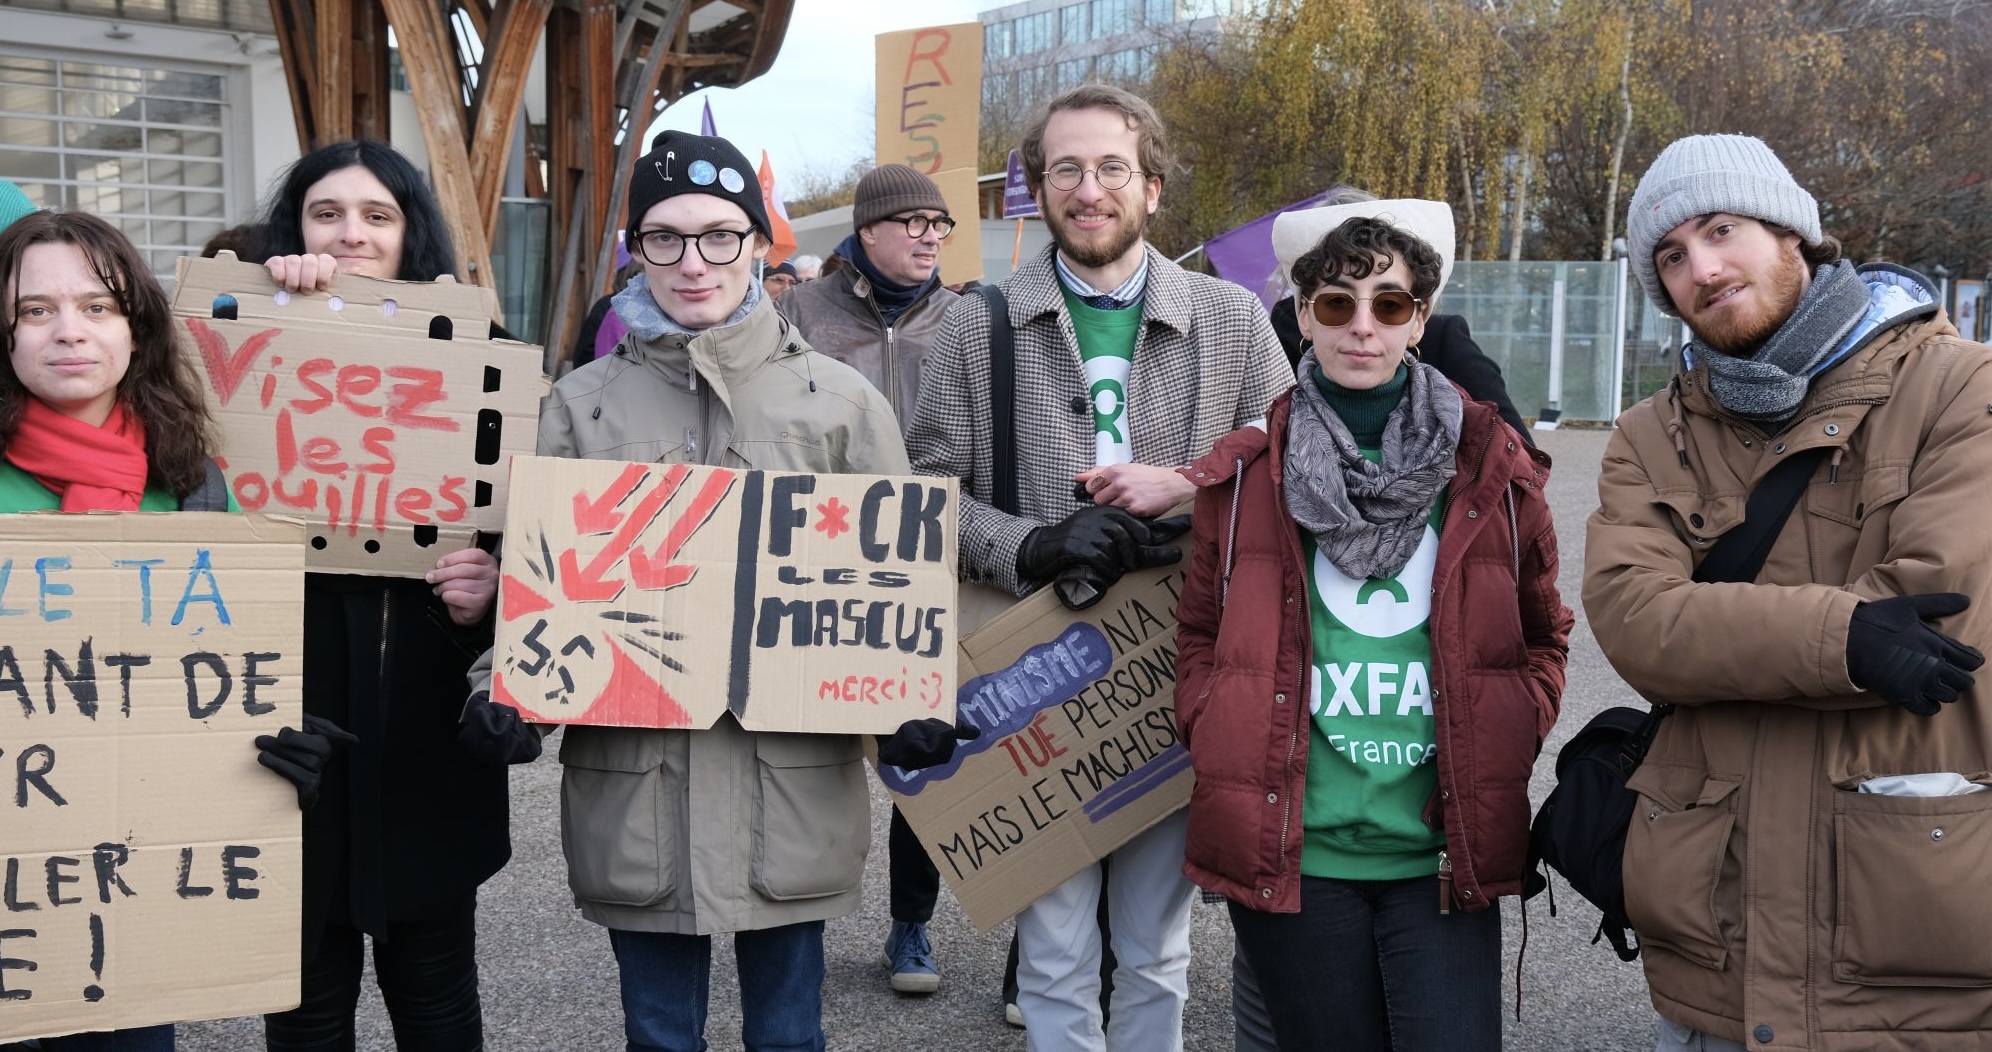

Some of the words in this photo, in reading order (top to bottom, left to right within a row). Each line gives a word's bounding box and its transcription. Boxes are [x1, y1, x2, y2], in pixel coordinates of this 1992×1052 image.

[185, 317, 460, 432] Visez
[275, 408, 396, 476] les
[213, 456, 471, 538] ouilles
[778, 565, 911, 588] LES
[756, 597, 947, 658] MASCUS
[180, 651, 282, 720] DE
[0, 743, 68, 808] R
[938, 804, 1024, 881] MAIS
[1018, 777, 1069, 831] LE
[176, 845, 262, 901] LE
